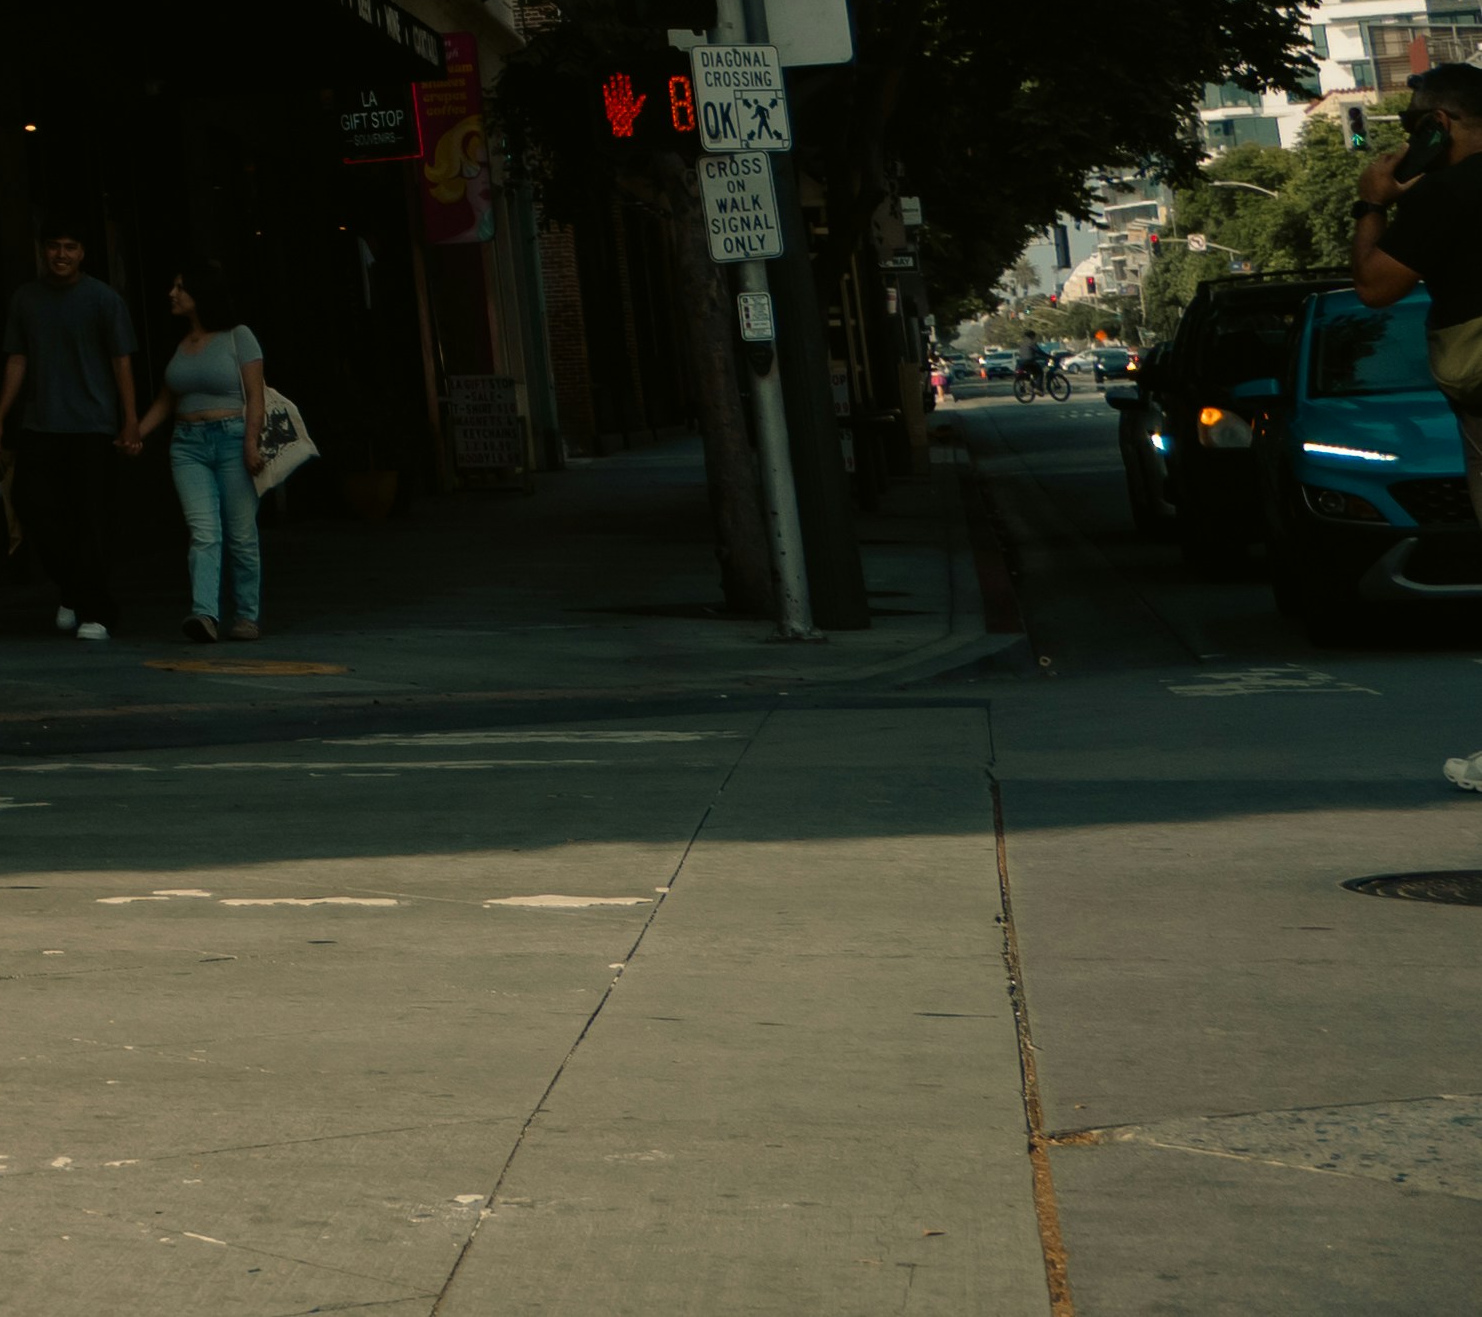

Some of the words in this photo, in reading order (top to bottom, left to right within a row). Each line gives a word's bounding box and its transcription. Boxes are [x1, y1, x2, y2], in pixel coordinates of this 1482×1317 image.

[701, 50, 771, 68] DIAGONAL
[704, 70, 773, 88] CROSSING
[360, 90, 379, 108] LA
[340, 112, 368, 131] GIFT
[370, 109, 404, 129] STOP
[703, 100, 738, 140] OK
[705, 158, 763, 180] CROSS
[726, 179, 746, 194] ON
[715, 195, 764, 215] WALK
[710, 215, 775, 235] SIGNAL
[722, 233, 767, 254] ONLY
